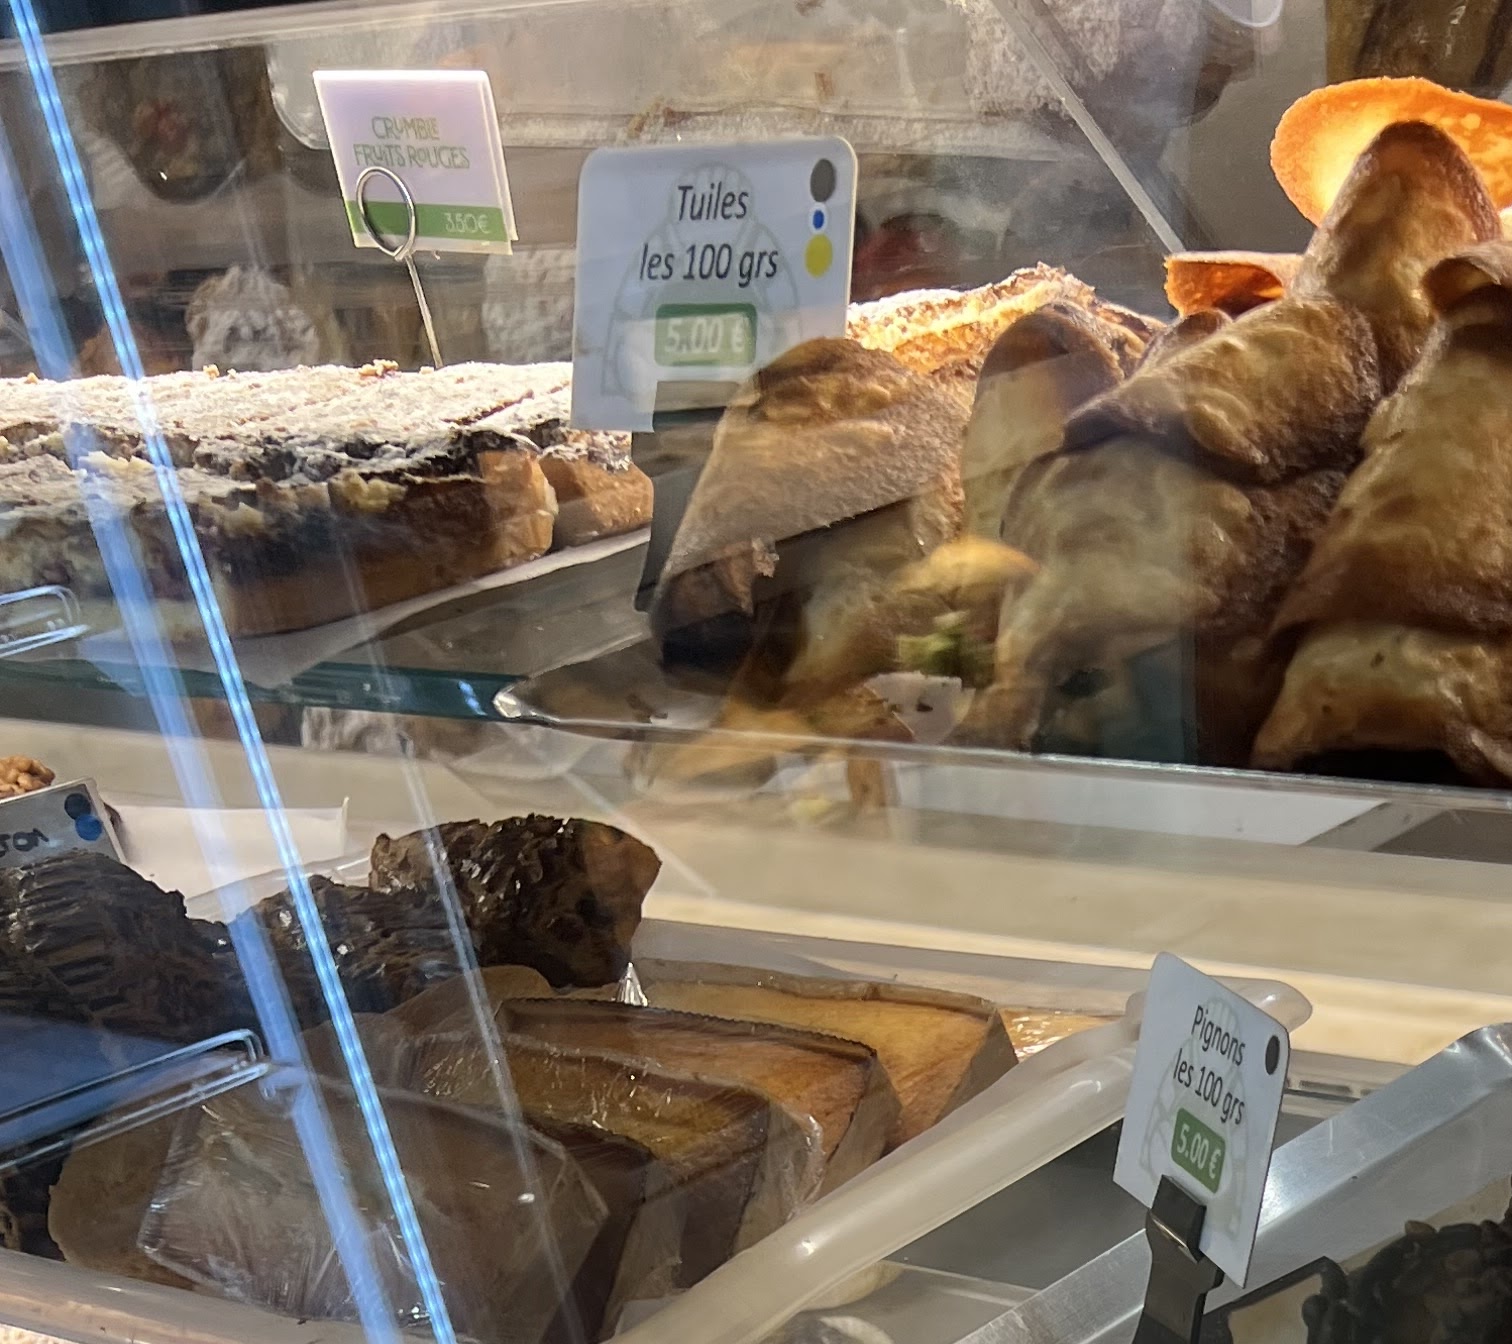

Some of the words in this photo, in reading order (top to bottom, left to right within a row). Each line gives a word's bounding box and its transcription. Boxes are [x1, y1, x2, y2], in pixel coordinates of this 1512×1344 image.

[372, 116, 439, 140] CRUMBLE
[408, 146, 470, 169] ROUGES
[677, 181, 749, 221] Tuiles
[640, 244, 674, 280] les
[683, 243, 732, 280] 100
[738, 250, 779, 288] grs
[665, 315, 723, 353] 5.00
[1191, 1004, 1246, 1066] Pignons
[1173, 1047, 1194, 1088] les
[1195, 1066, 1224, 1107] 100
[1220, 1089, 1245, 1125] grs
[1177, 1122, 1208, 1169] 5.00
[1208, 1148, 1222, 1180] €
